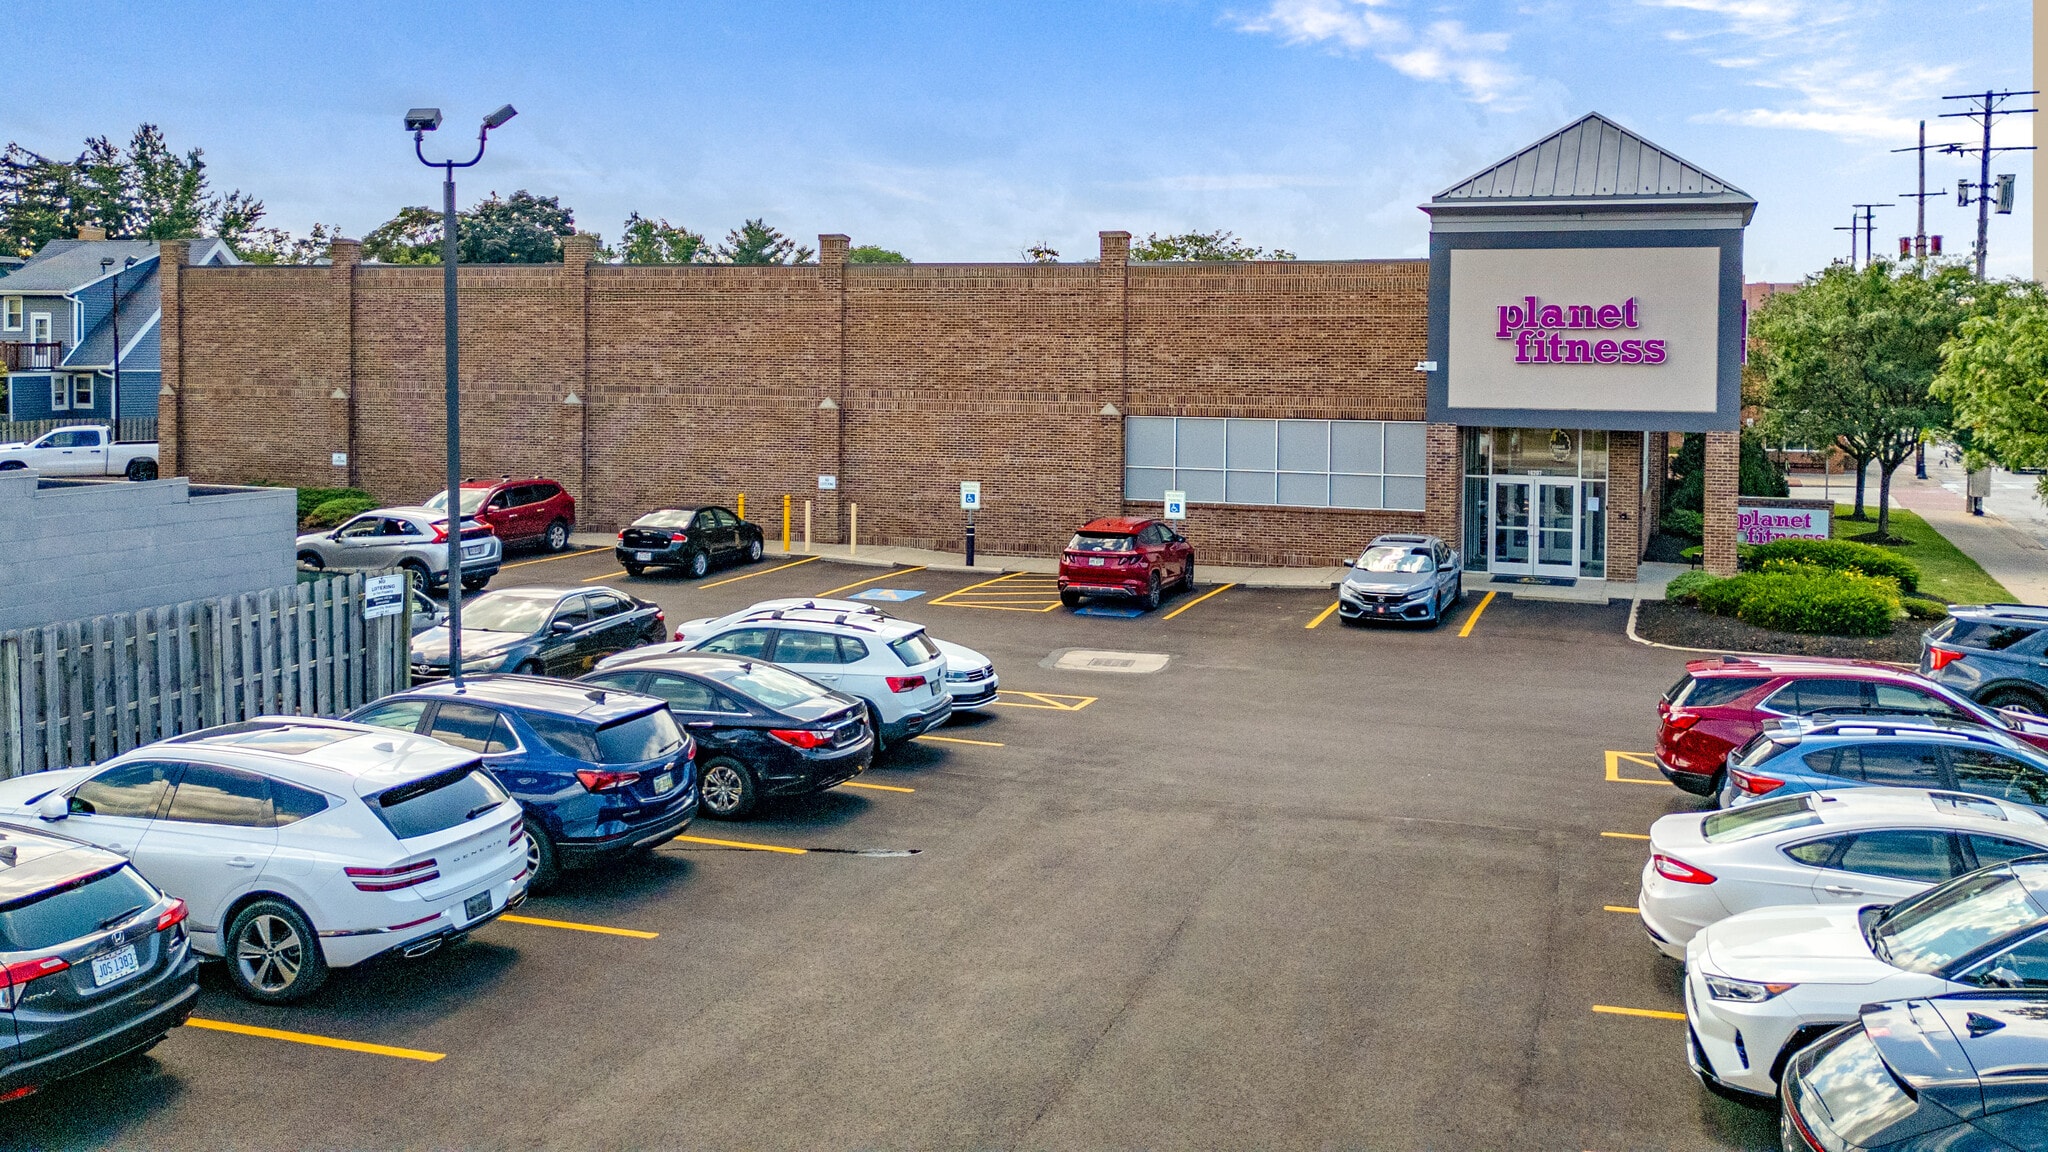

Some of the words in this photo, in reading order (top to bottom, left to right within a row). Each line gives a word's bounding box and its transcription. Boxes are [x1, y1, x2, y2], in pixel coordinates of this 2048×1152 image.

[1496, 296, 1638, 338] planet
[1514, 330, 1666, 364] fitness
[1738, 509, 1811, 531] planet
[114, 953, 134, 972] 1383
